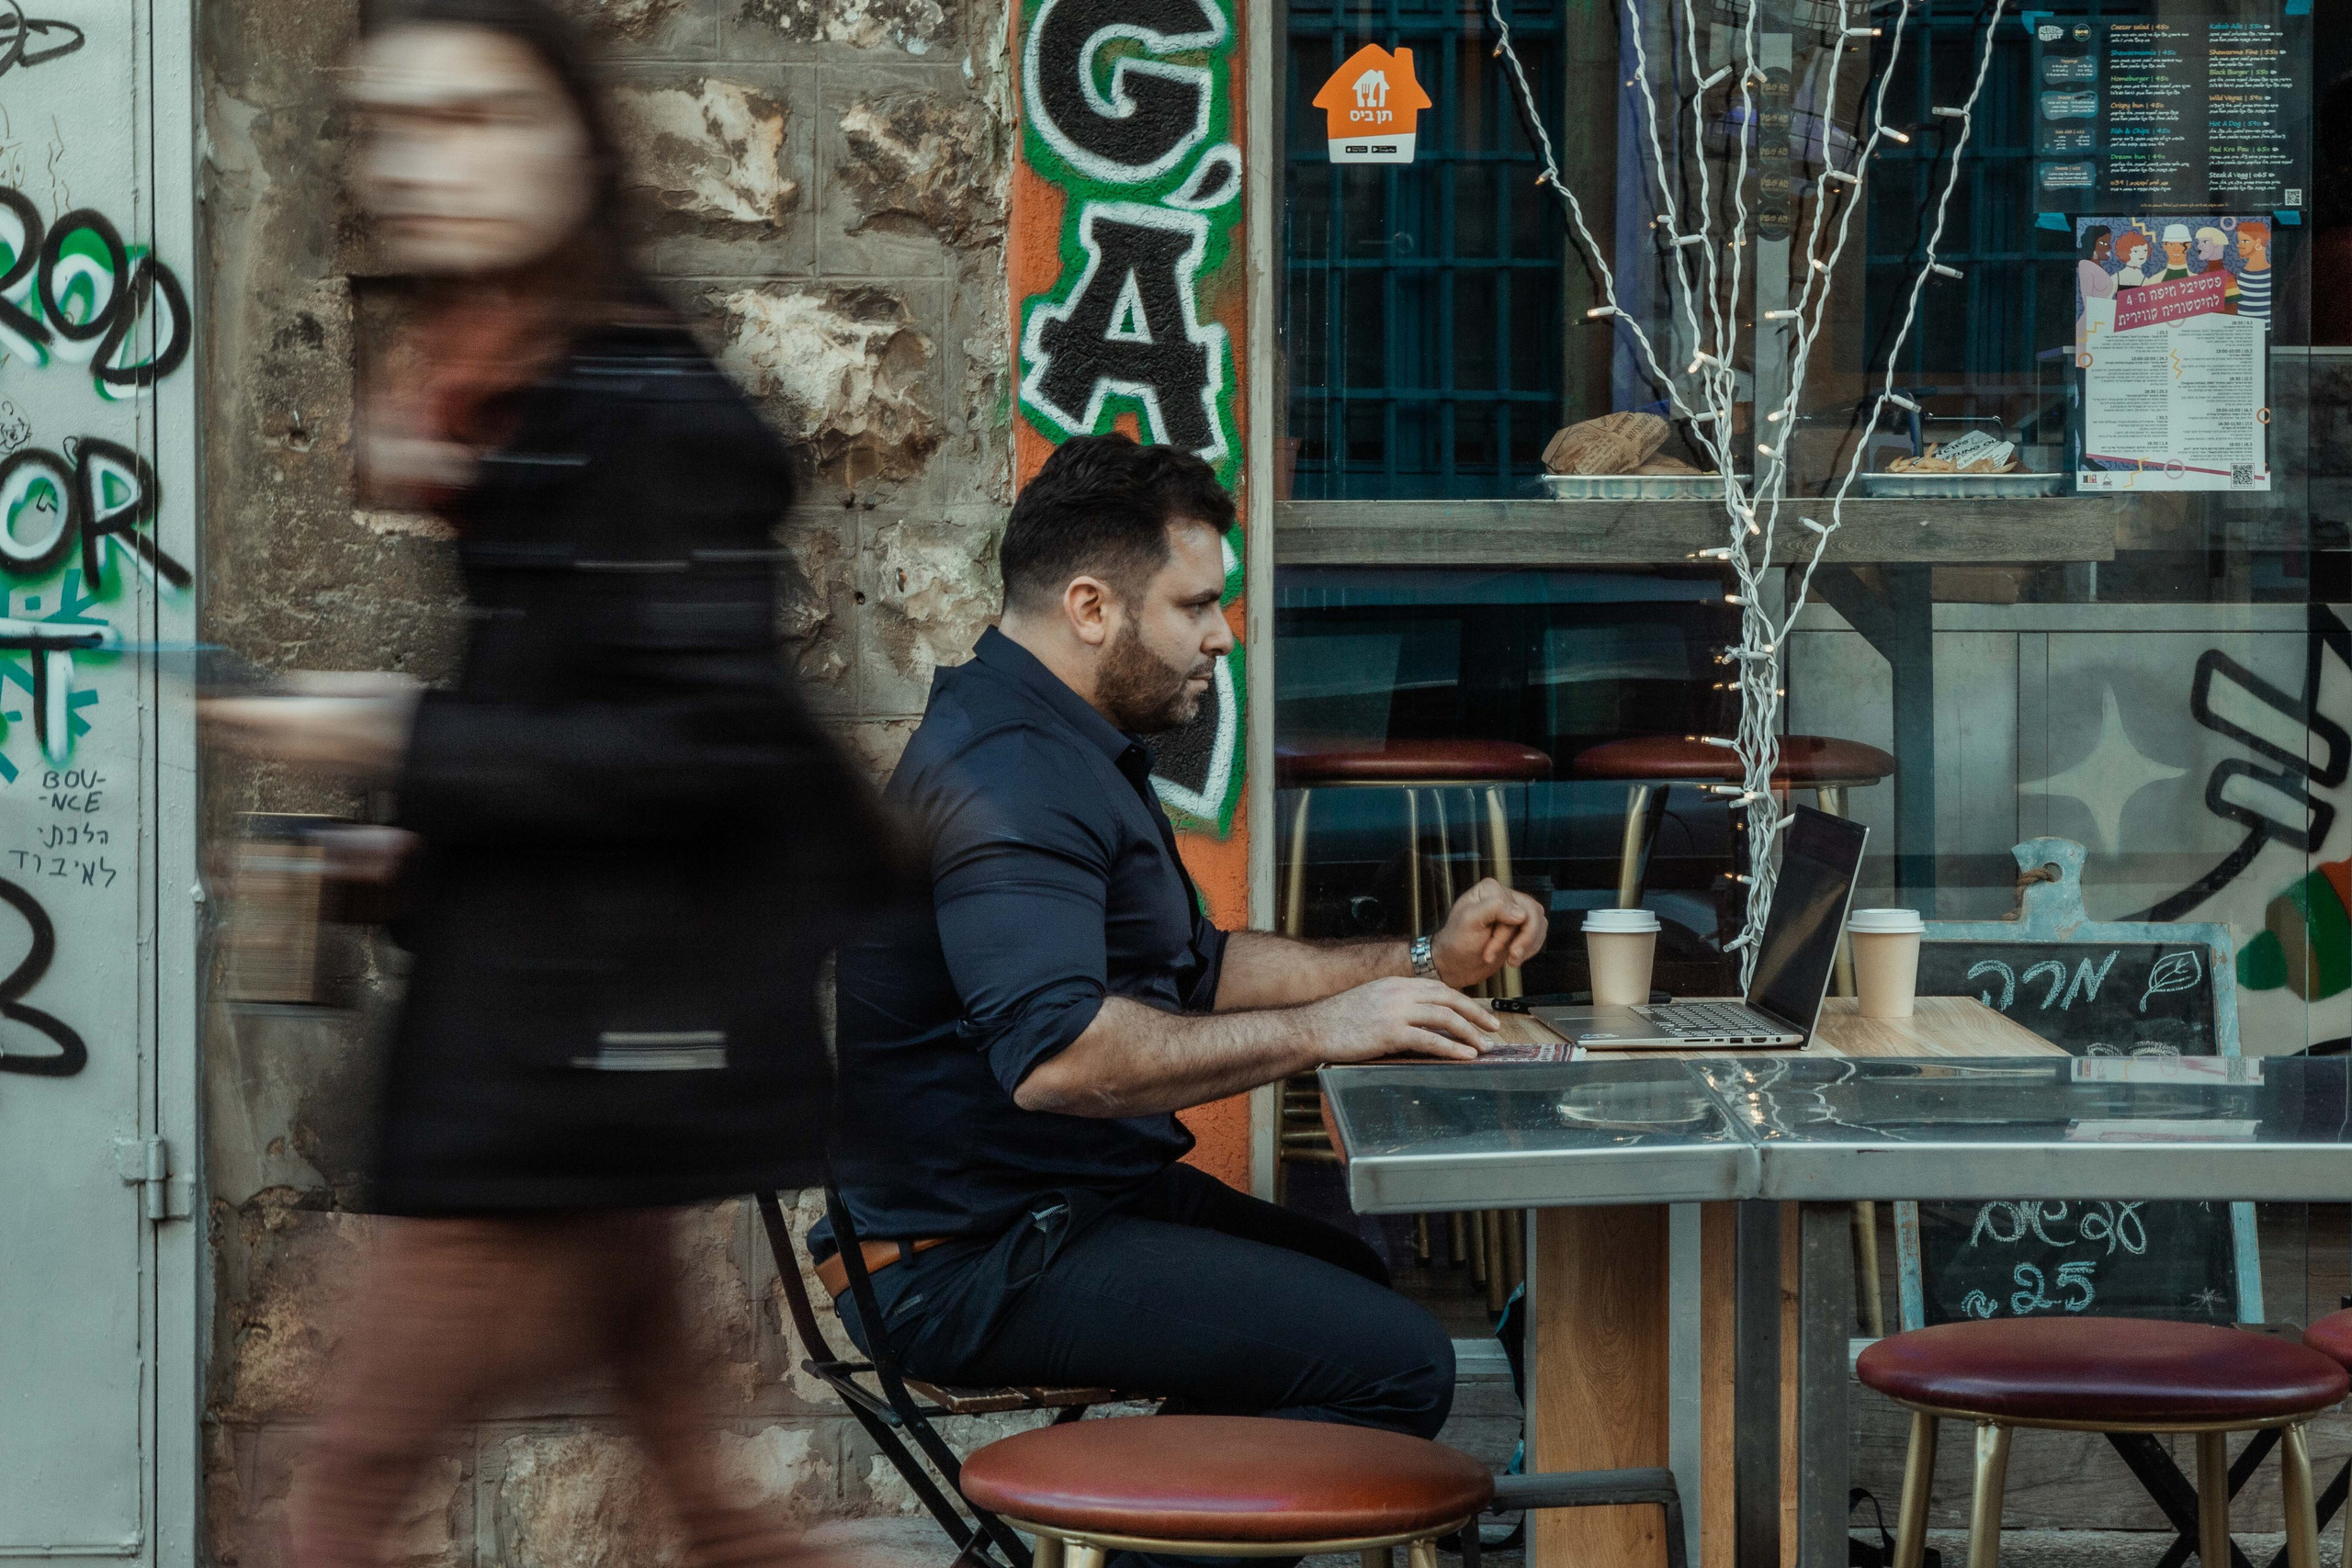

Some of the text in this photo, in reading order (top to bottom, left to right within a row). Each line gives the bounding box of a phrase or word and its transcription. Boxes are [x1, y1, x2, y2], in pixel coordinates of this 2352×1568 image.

[2227, 69, 2249, 77] Burger
[1349, 110, 1393, 125] תן ביס
[2150, 285, 2177, 301] חיפה
[2180, 276, 2222, 294] פסטיבל
[2118, 294, 2220, 326] להיסטוריה קווירית
[1613, 414, 1635, 435] Churchill
[37, 821, 109, 848] הלכתי
[8, 850, 117, 888] לאיבוד
[2010, 1261, 2098, 1315] 25
